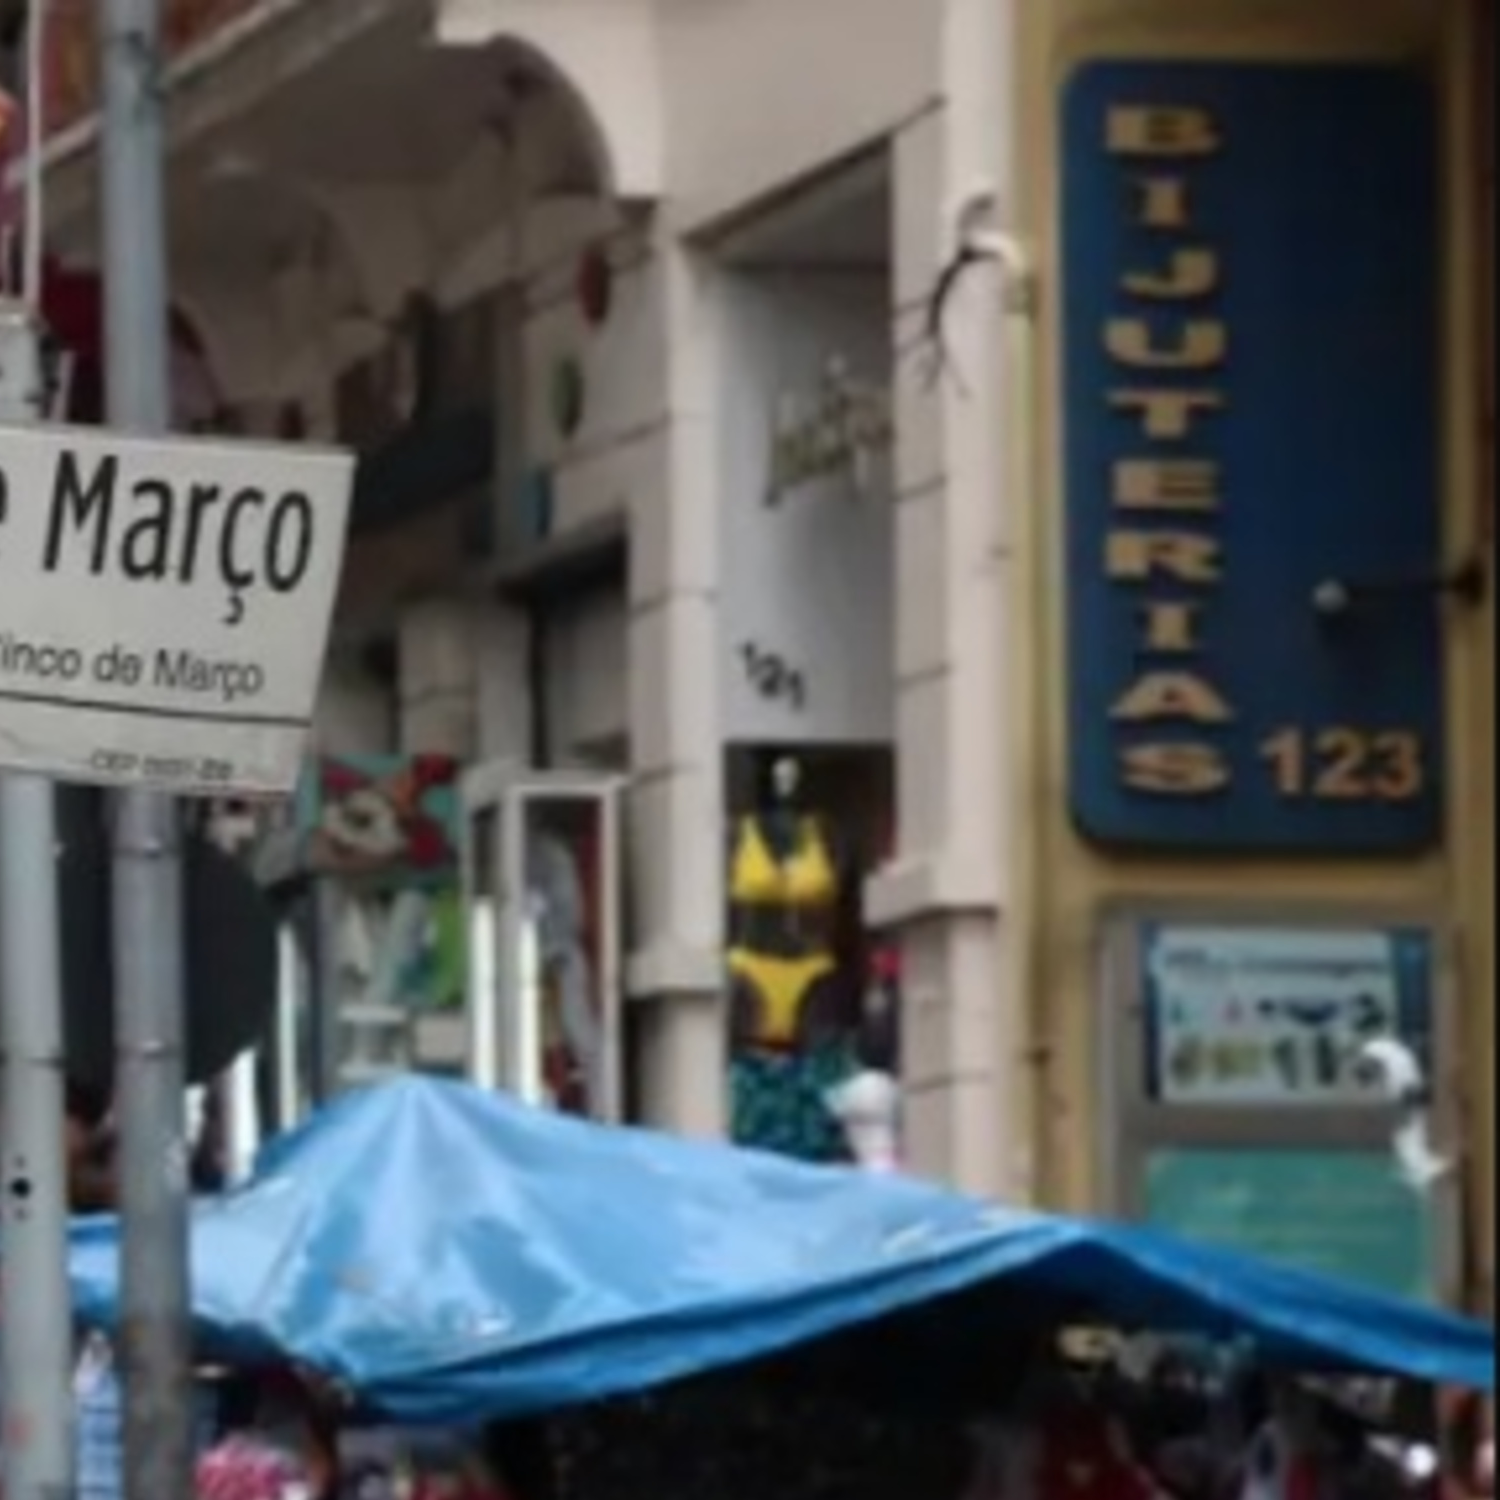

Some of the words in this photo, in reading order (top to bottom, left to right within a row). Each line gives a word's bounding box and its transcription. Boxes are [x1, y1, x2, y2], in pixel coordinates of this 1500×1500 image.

[1105, 106, 1232, 795] BIJUTERIAS
[42, 448, 314, 626] Março
[92, 643, 142, 687] de
[152, 647, 264, 702] Março
[1260, 727, 1421, 797] 123
